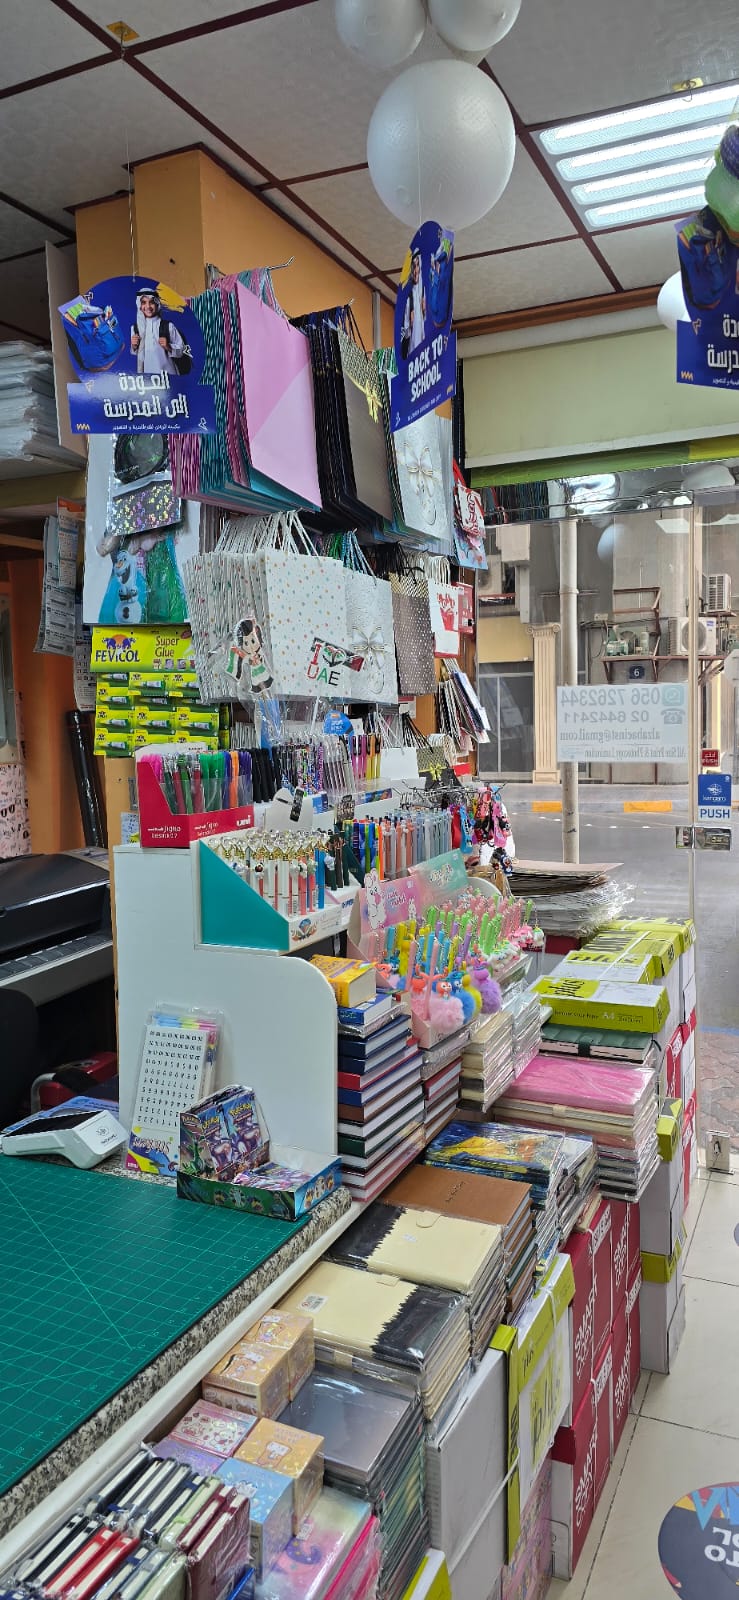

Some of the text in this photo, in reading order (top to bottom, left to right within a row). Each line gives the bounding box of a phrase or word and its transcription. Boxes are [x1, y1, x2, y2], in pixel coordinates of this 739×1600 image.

[408, 334, 443, 382] BACK TO
[118, 370, 170, 395] العودة
[410, 361, 442, 402] SCHOOL
[103, 393, 190, 420] إلى المدرسة
[155, 636, 180, 648] Super
[95, 650, 140, 662] FEVICOL
[155, 648, 174, 658] Glue
[311, 642, 322, 665] I
[307, 667, 341, 687] UAE
[700, 808, 730, 819] PUSH
